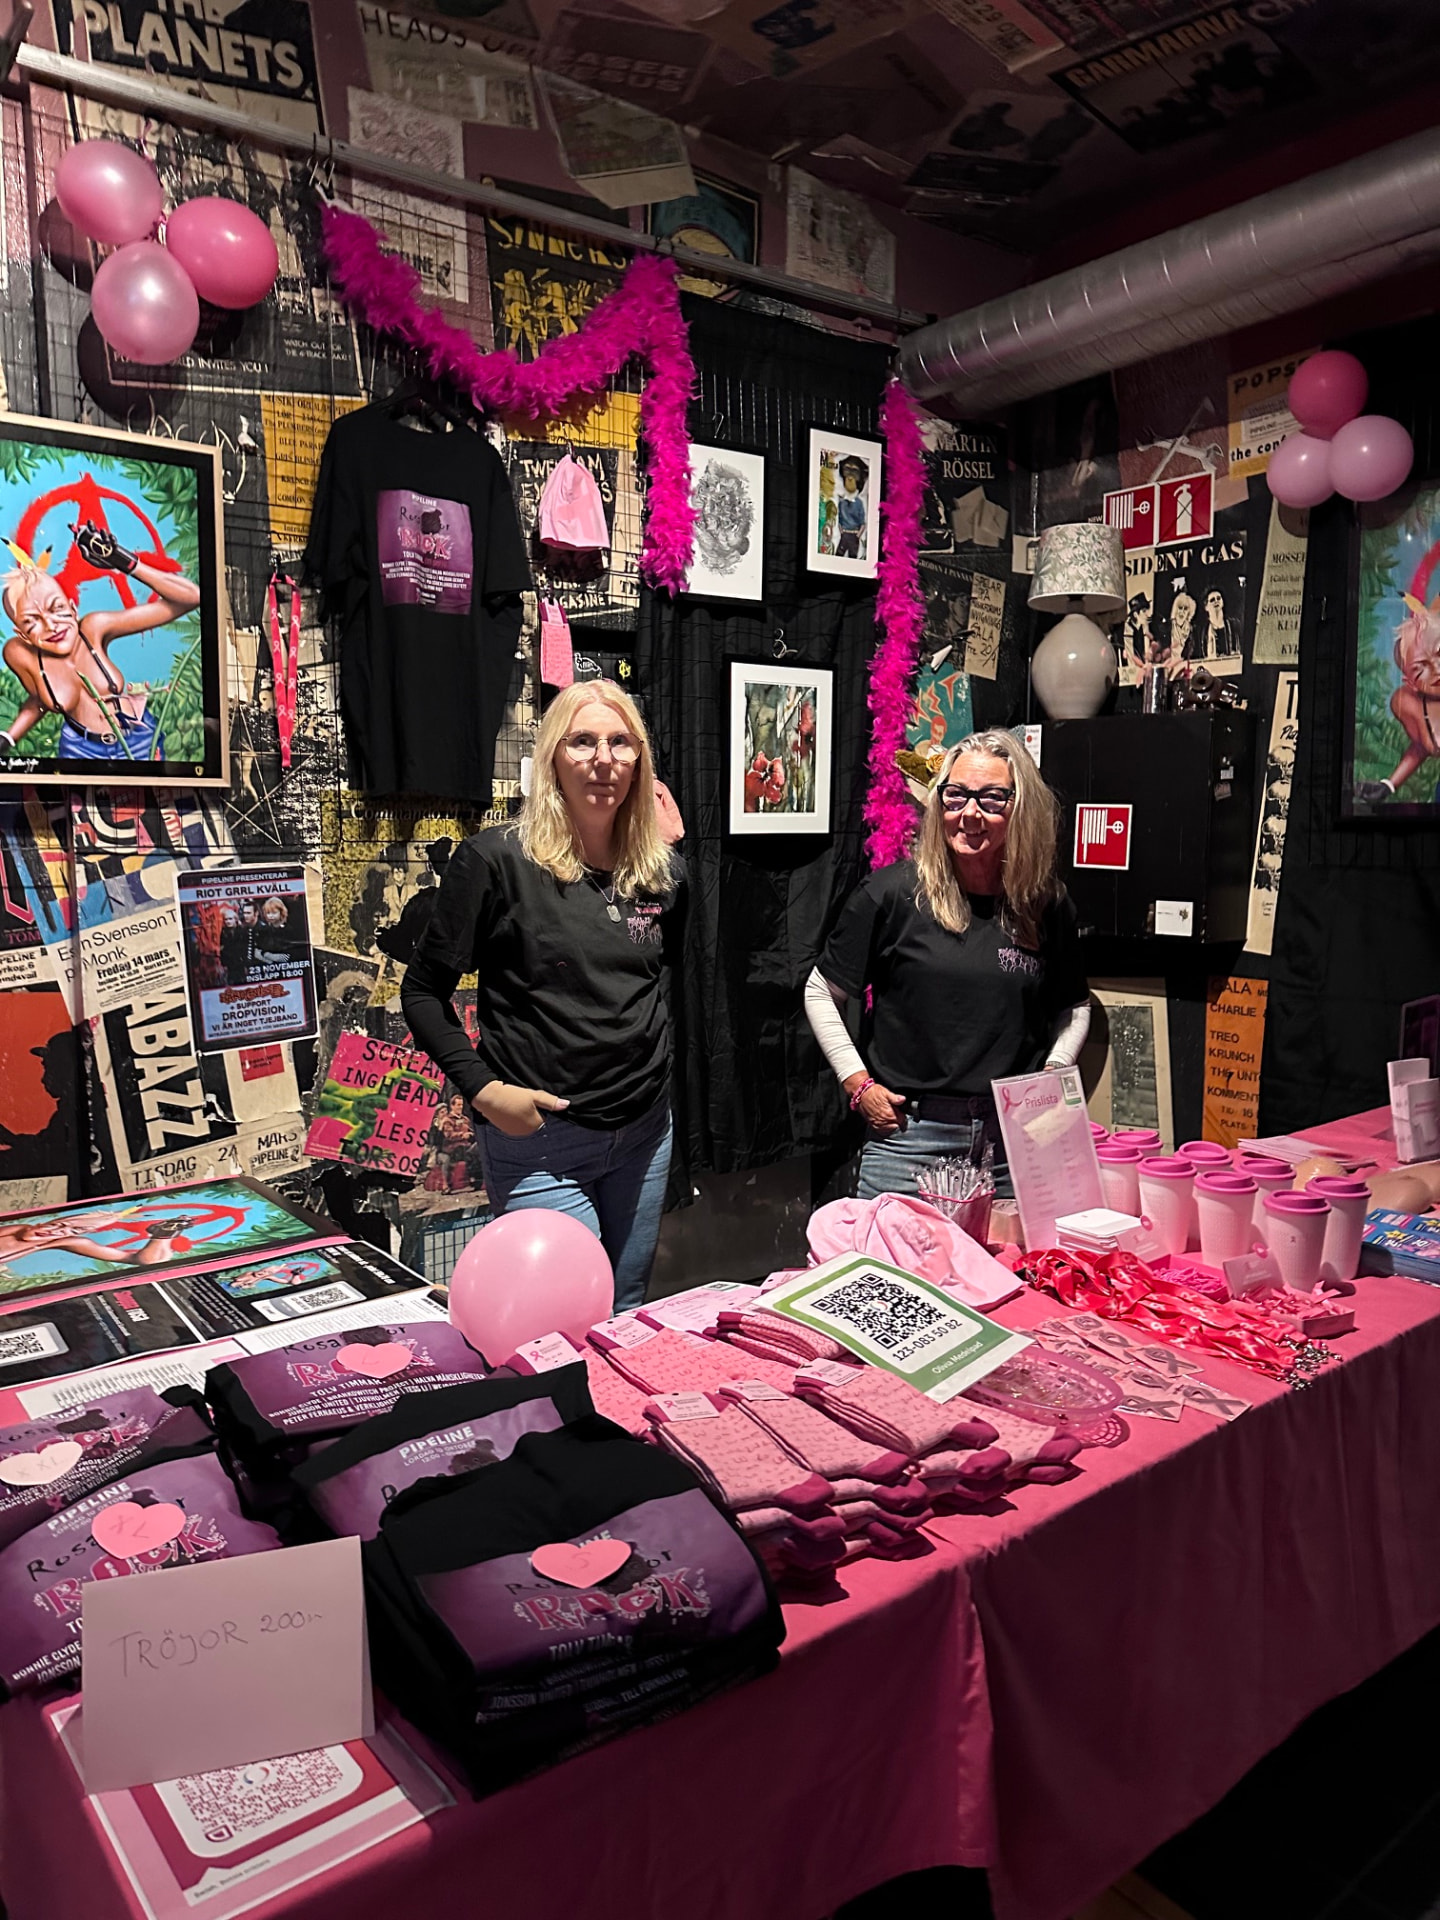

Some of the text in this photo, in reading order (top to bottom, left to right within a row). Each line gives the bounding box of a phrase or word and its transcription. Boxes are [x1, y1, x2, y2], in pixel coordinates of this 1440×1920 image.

[1067, 7, 1246, 90] GARMARNA
[198, 357, 237, 372] INVITES
[1234, 358, 1309, 395] POPS
[937, 433, 998, 453] MARTIN
[1230, 447, 1252, 461] the
[943, 457, 995, 479] RÖSSEL
[1124, 540, 1244, 577] SIDENT GAS
[201, 871, 288, 885] PIPELINE PRESENTERAR
[195, 881, 291, 899] RIOT GRRL KVÄLL
[91, 914, 168, 947] Svensson
[82, 946, 128, 972] Monk
[96, 948, 170, 979] Fredag 14 mars
[249, 959, 311, 975] 23 NOVEMBER
[281, 968, 304, 979] 18:00
[221, 1004, 286, 1022] DROPVISION
[236, 999, 272, 1011] SUPPORT
[1210, 1002, 1256, 1018] CHARLIE
[211, 1024, 220, 1033] VI
[221, 1020, 232, 1031] ÄR
[234, 1017, 257, 1029] INGET
[259, 1012, 298, 1027] TJEJBAND
[1210, 1030, 1240, 1044] TREO
[1209, 1046, 1255, 1065] KRUNCH
[1025, 1093, 1059, 1109] Prislista
[376, 1119, 429, 1148] LESS
[132, 1155, 197, 1187] TISDAG
[257, 1132, 298, 1151] MARS
[251, 1147, 290, 1168] PIPELINE
[339, 1137, 422, 1175] TORSOS
[893, 1319, 962, 1361] 123-083 50 82
[310, 1385, 337, 1398] TOLV
[321, 1398, 350, 1411] UNITED
[283, 1413, 308, 1427] PETER
[399, 1426, 475, 1460] PIPELINE
[47, 1481, 131, 1531] PIPELINE
[13, 1639, 83, 1681] BONNIE CLYDE
